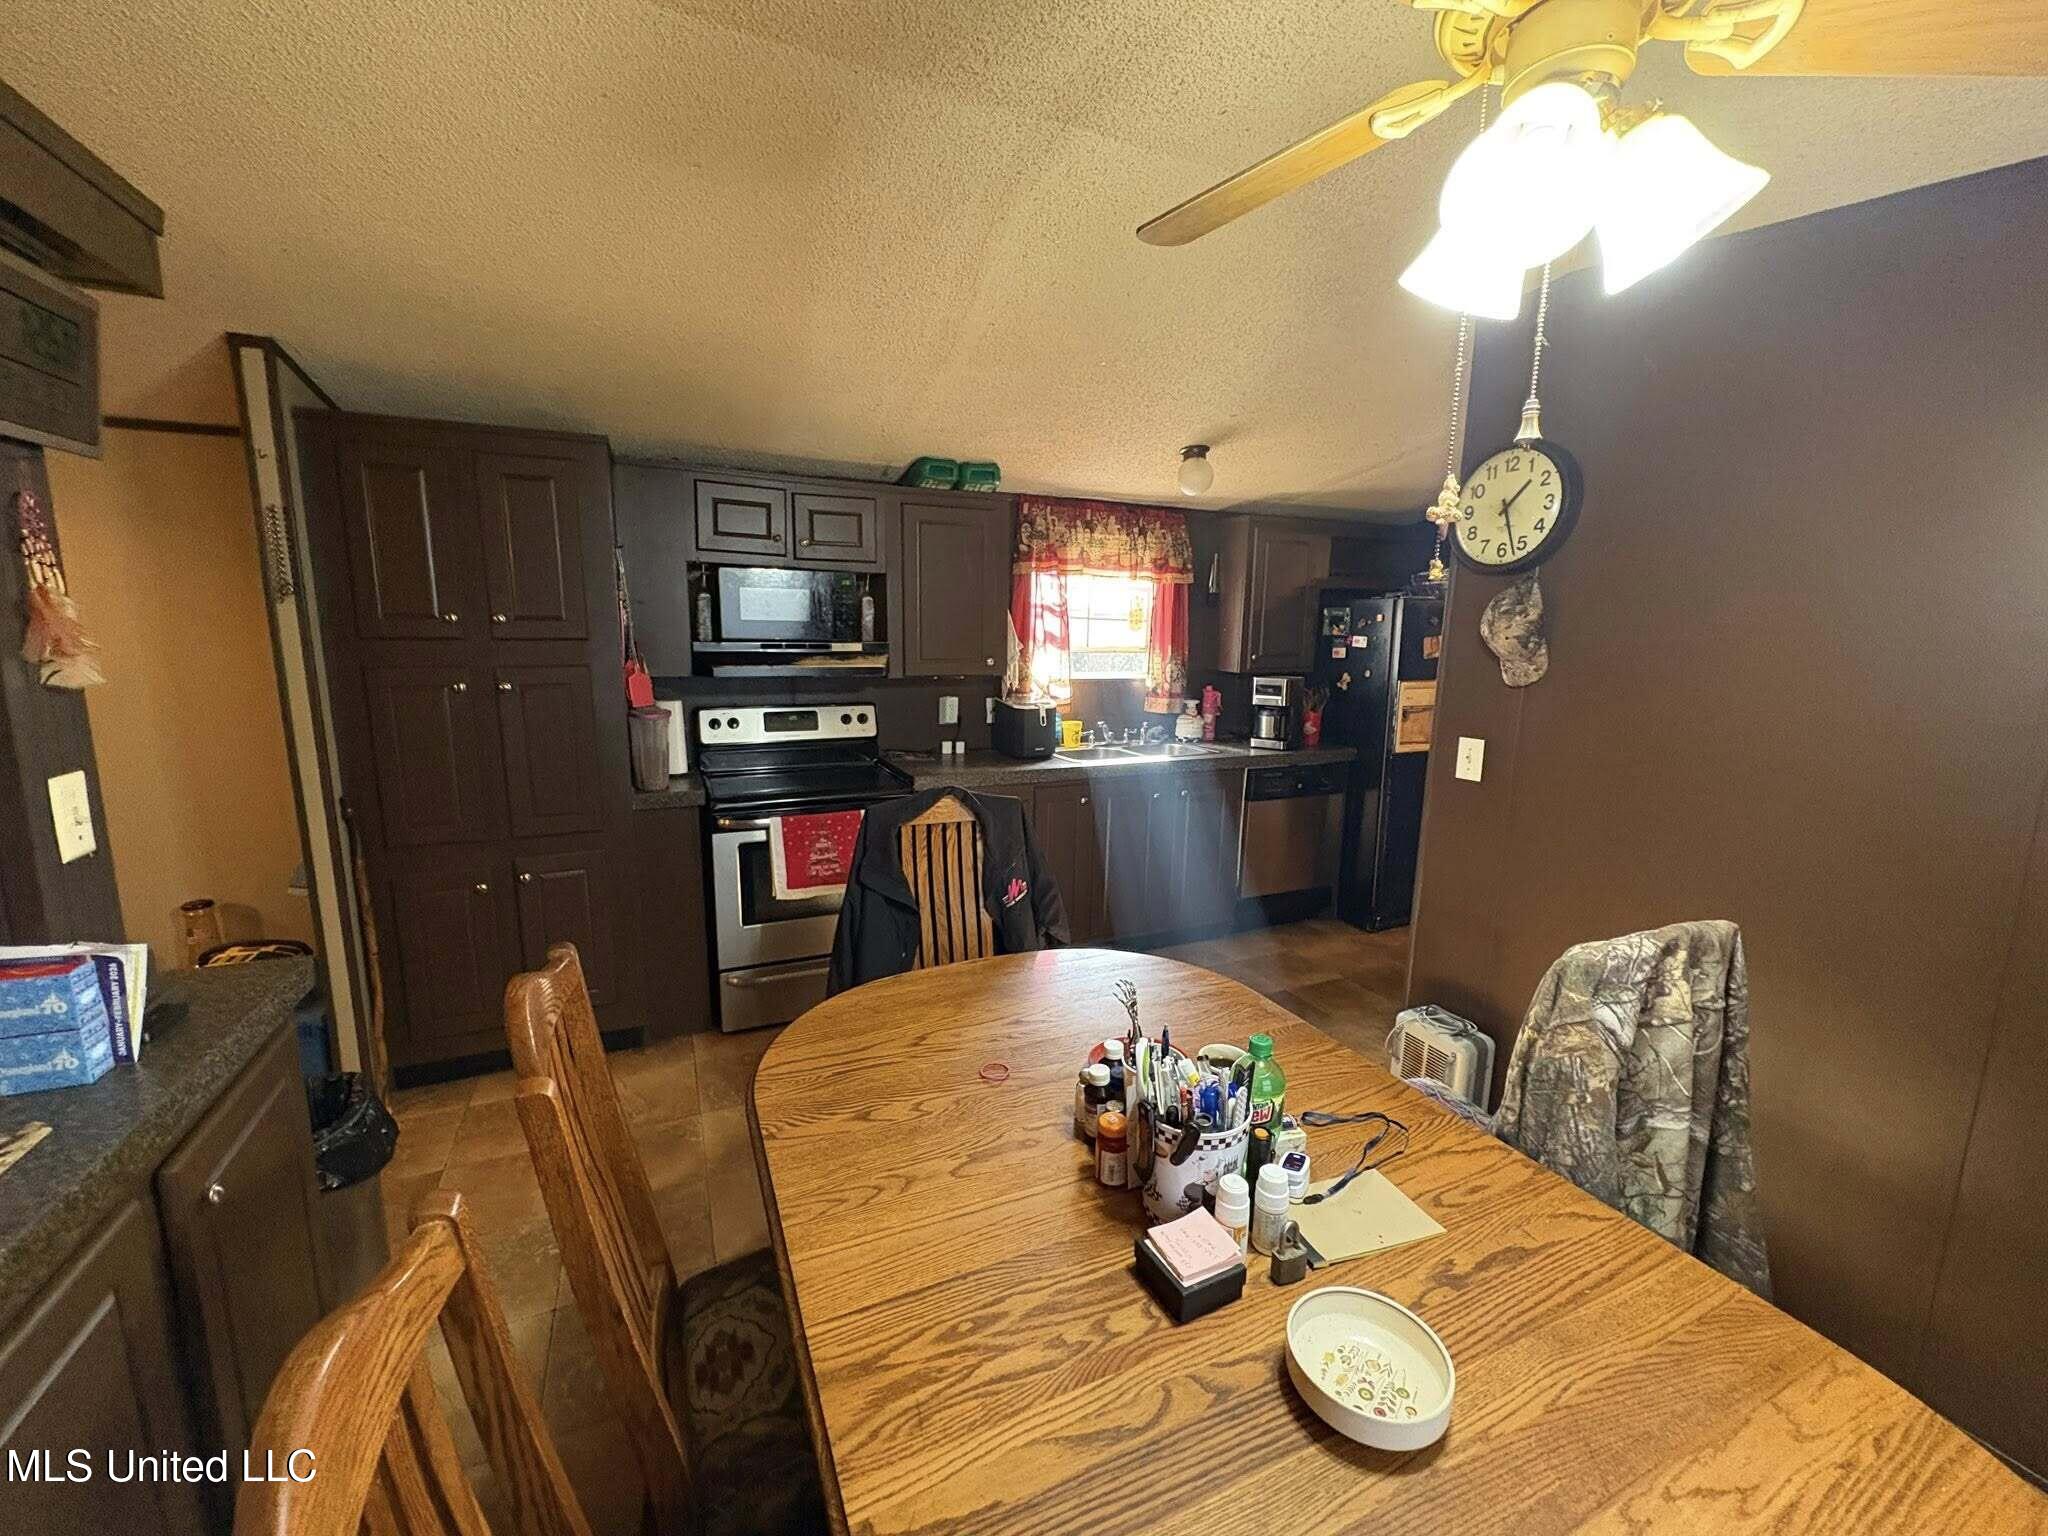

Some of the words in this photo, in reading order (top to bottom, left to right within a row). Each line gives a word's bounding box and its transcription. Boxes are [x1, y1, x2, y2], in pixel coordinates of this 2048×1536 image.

[1505, 456, 1520, 473] 12
[1528, 457, 1535, 473] 1
[1486, 465, 1498, 481] 11
[1540, 470, 1551, 486] 2
[1471, 483, 1485, 500] 10
[1543, 493, 1555, 510] 3
[1464, 506, 1474, 520] 9
[1466, 526, 1478, 541] 8
[1534, 518, 1546, 533] 4
[1480, 539, 1491, 554] 7
[1496, 542, 1507, 558] 6
[1516, 535, 1528, 551] 5
[1252, 1106, 1271, 1122] ew
